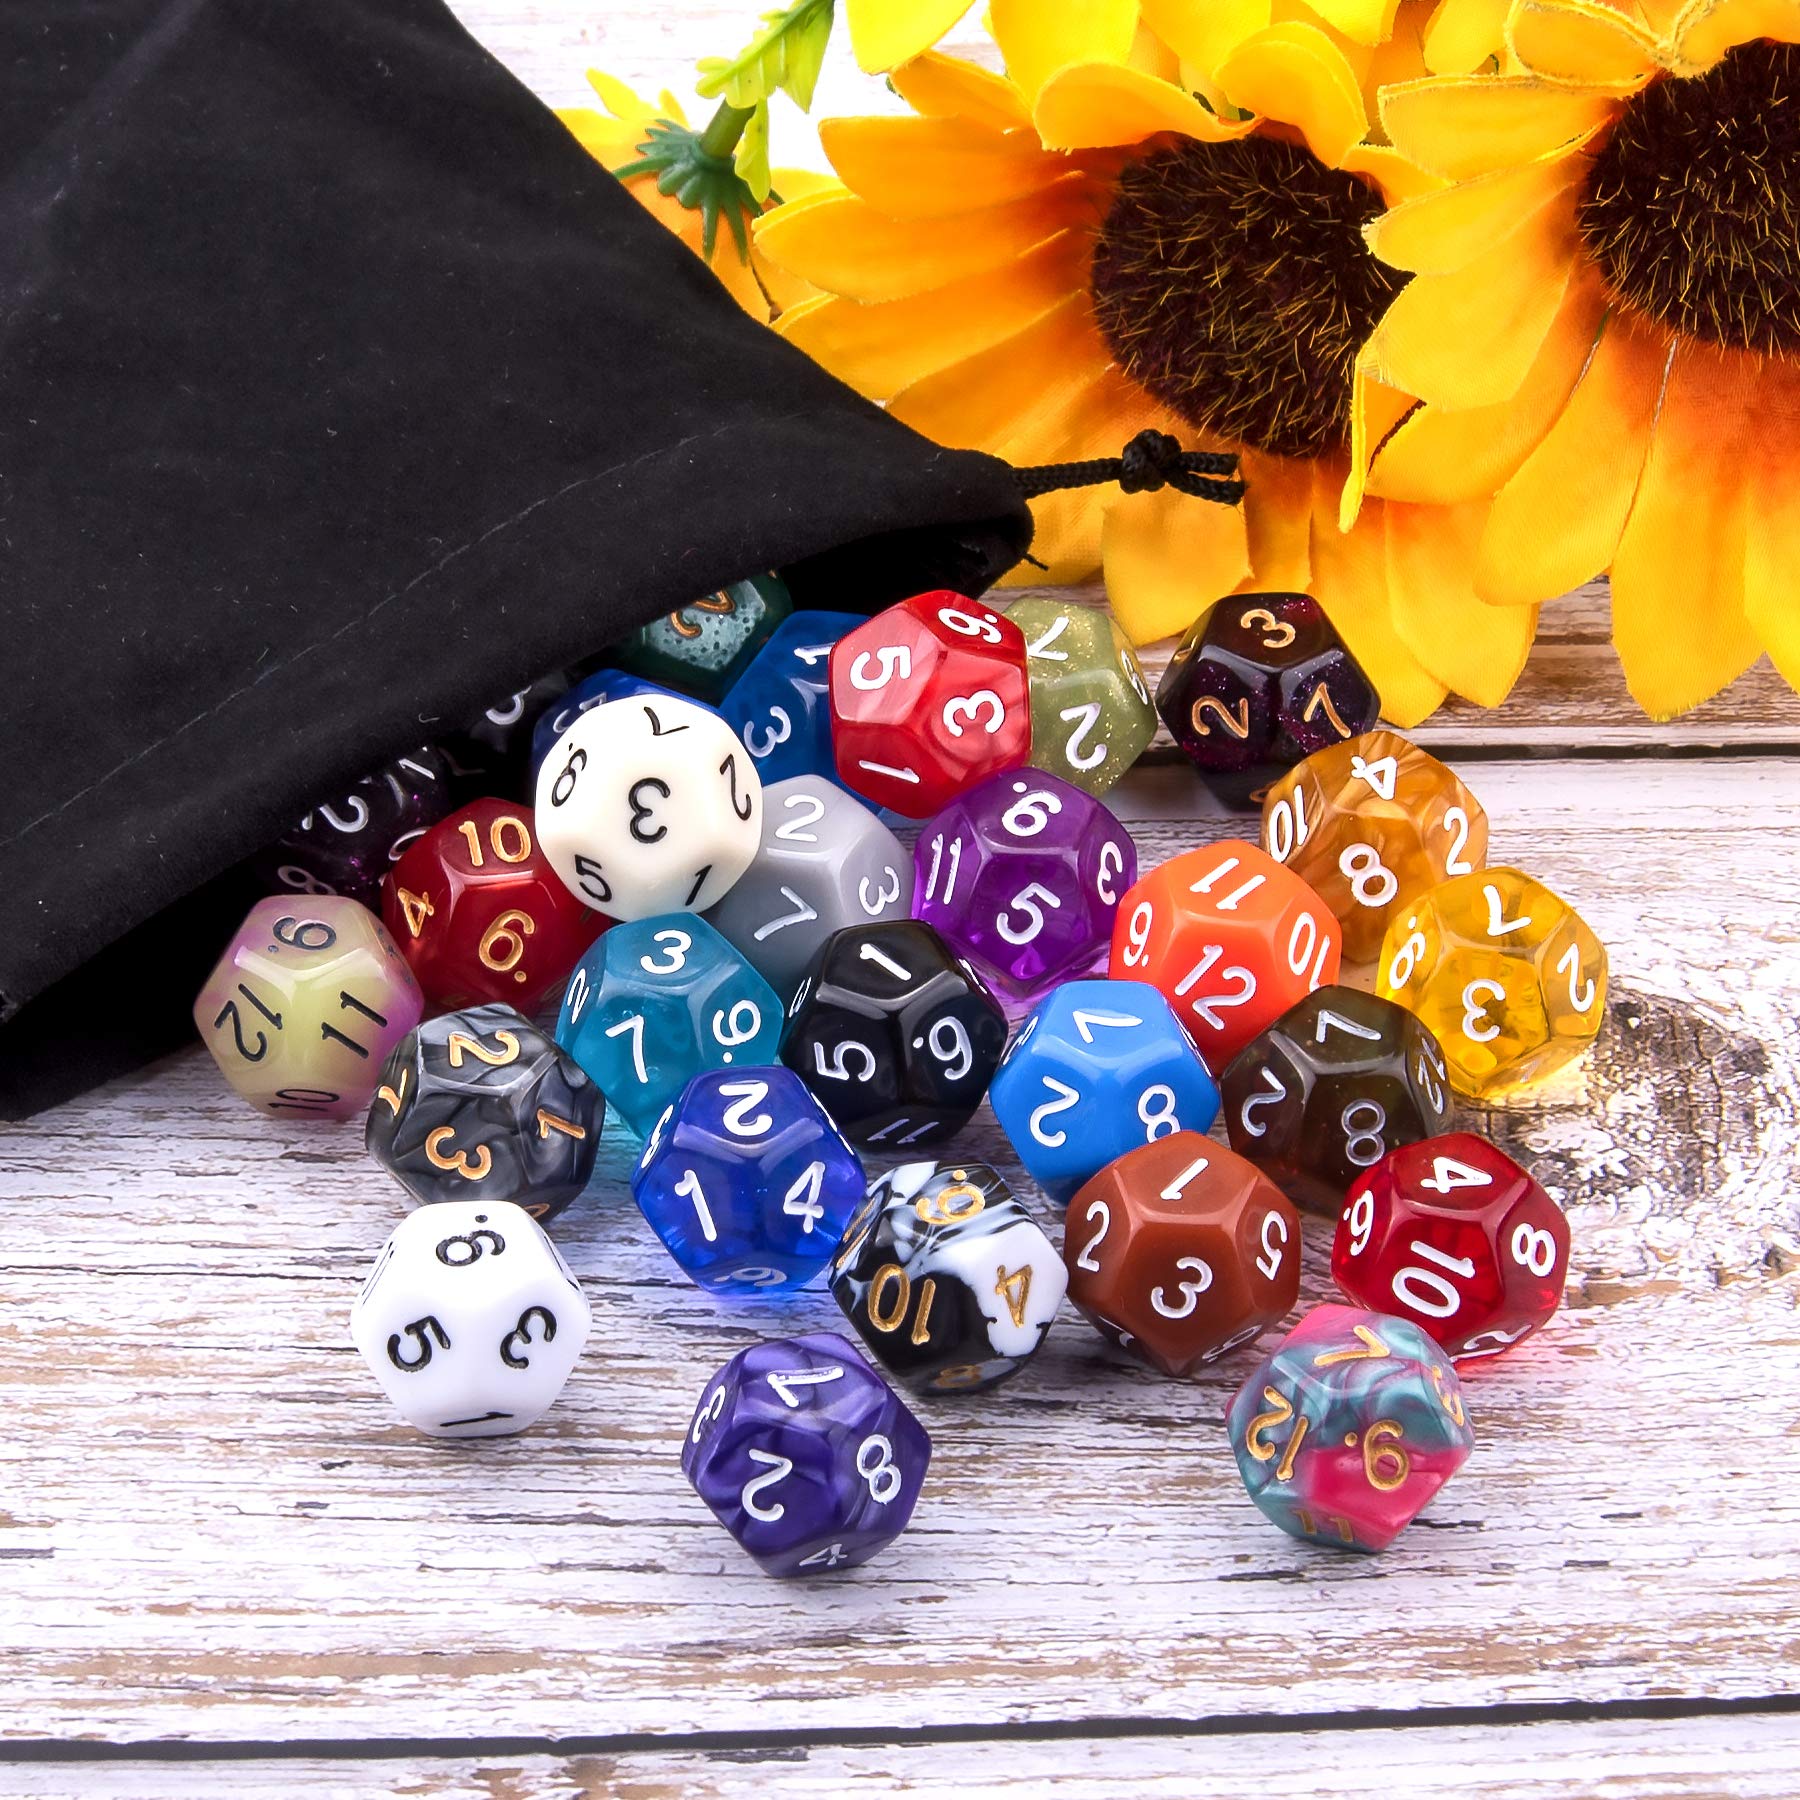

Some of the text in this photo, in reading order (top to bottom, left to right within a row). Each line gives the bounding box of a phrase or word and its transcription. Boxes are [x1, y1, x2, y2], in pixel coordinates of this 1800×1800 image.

[1240, 608, 1296, 648] 3
[850, 645, 912, 691] 5
[643, 706, 690, 736] 7
[744, 705, 792, 758] 3
[942, 690, 1006, 737] 3
[1059, 702, 1108, 770] 2
[1191, 694, 1249, 739] 2
[1303, 681, 1351, 739] 7
[718, 753, 752, 822] 2
[858, 759, 921, 784] 1
[1350, 755, 1399, 801] 4
[627, 776, 671, 844] 3
[774, 793, 826, 843] 2
[1267, 783, 1310, 864] 10
[457, 815, 533, 867] 10
[924, 832, 963, 905] 11
[1443, 806, 1472, 876] 2
[574, 853, 613, 903] 5
[684, 864, 713, 906] 1
[858, 865, 901, 917] 3
[1096, 840, 1124, 906] 3
[1189, 857, 1267, 911] 11
[1338, 842, 1399, 908] 8
[397, 886, 435, 938] 4
[753, 885, 818, 942] 7
[996, 882, 1062, 946] 5
[1482, 884, 1533, 937] 7
[639, 929, 694, 975] 3
[858, 942, 913, 982] 1
[1556, 942, 1596, 1013] 2
[1174, 944, 1258, 1031] 12
[1461, 978, 1507, 1043] 3
[213, 983, 284, 1063] 12
[320, 990, 389, 1059] 11
[448, 1029, 521, 1068] 2
[604, 1014, 650, 1084] 7
[1070, 1009, 1144, 1045] 7
[1315, 1008, 1384, 1044] 7
[813, 1040, 877, 1082] 5
[717, 1079, 774, 1137] 2
[1027, 1075, 1081, 1149] 2
[1137, 1083, 1182, 1144] 8
[1240, 1065, 1288, 1137] 2
[423, 1126, 493, 1182] 3
[1341, 1100, 1386, 1167] 8
[782, 1160, 826, 1235] 4
[1160, 1157, 1209, 1201] 1
[1419, 1156, 1494, 1194] 4
[673, 1168, 718, 1243] 1
[1076, 1200, 1112, 1273] 2
[1255, 1209, 1289, 1282] 5
[1510, 1222, 1557, 1278] 8
[867, 1262, 937, 1345] 10
[994, 1263, 1034, 1329] 4
[1151, 1255, 1214, 1320] 3
[1391, 1239, 1477, 1319] 10
[386, 1314, 452, 1373] 5
[498, 1304, 558, 1370] 3
[1313, 1324, 1391, 1367] 7
[692, 1384, 727, 1444] 3
[767, 1365, 845, 1409] 7
[1245, 1385, 1310, 1483] 12
[741, 1448, 793, 1523] 2
[856, 1433, 902, 1505] 8
[798, 1543, 849, 1567] 4
